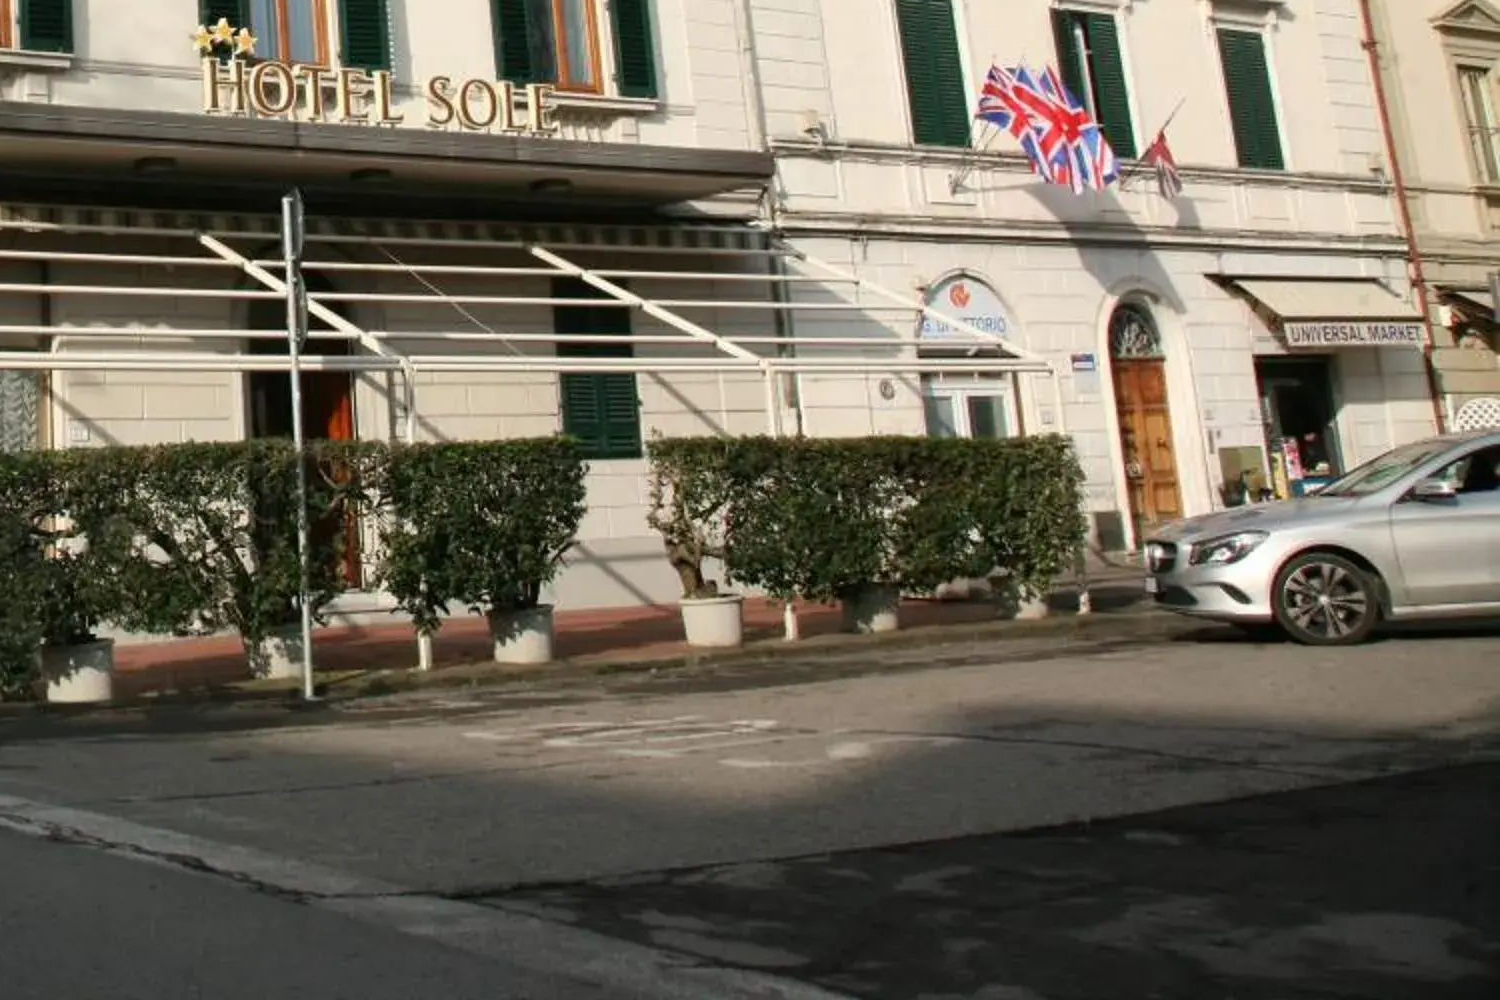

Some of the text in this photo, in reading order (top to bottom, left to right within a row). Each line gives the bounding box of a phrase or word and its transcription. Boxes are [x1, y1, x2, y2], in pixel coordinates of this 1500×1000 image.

[202, 57, 559, 136] HOTEL SOLE
[1290, 325, 1420, 343] UNIVERSAL MARKET
